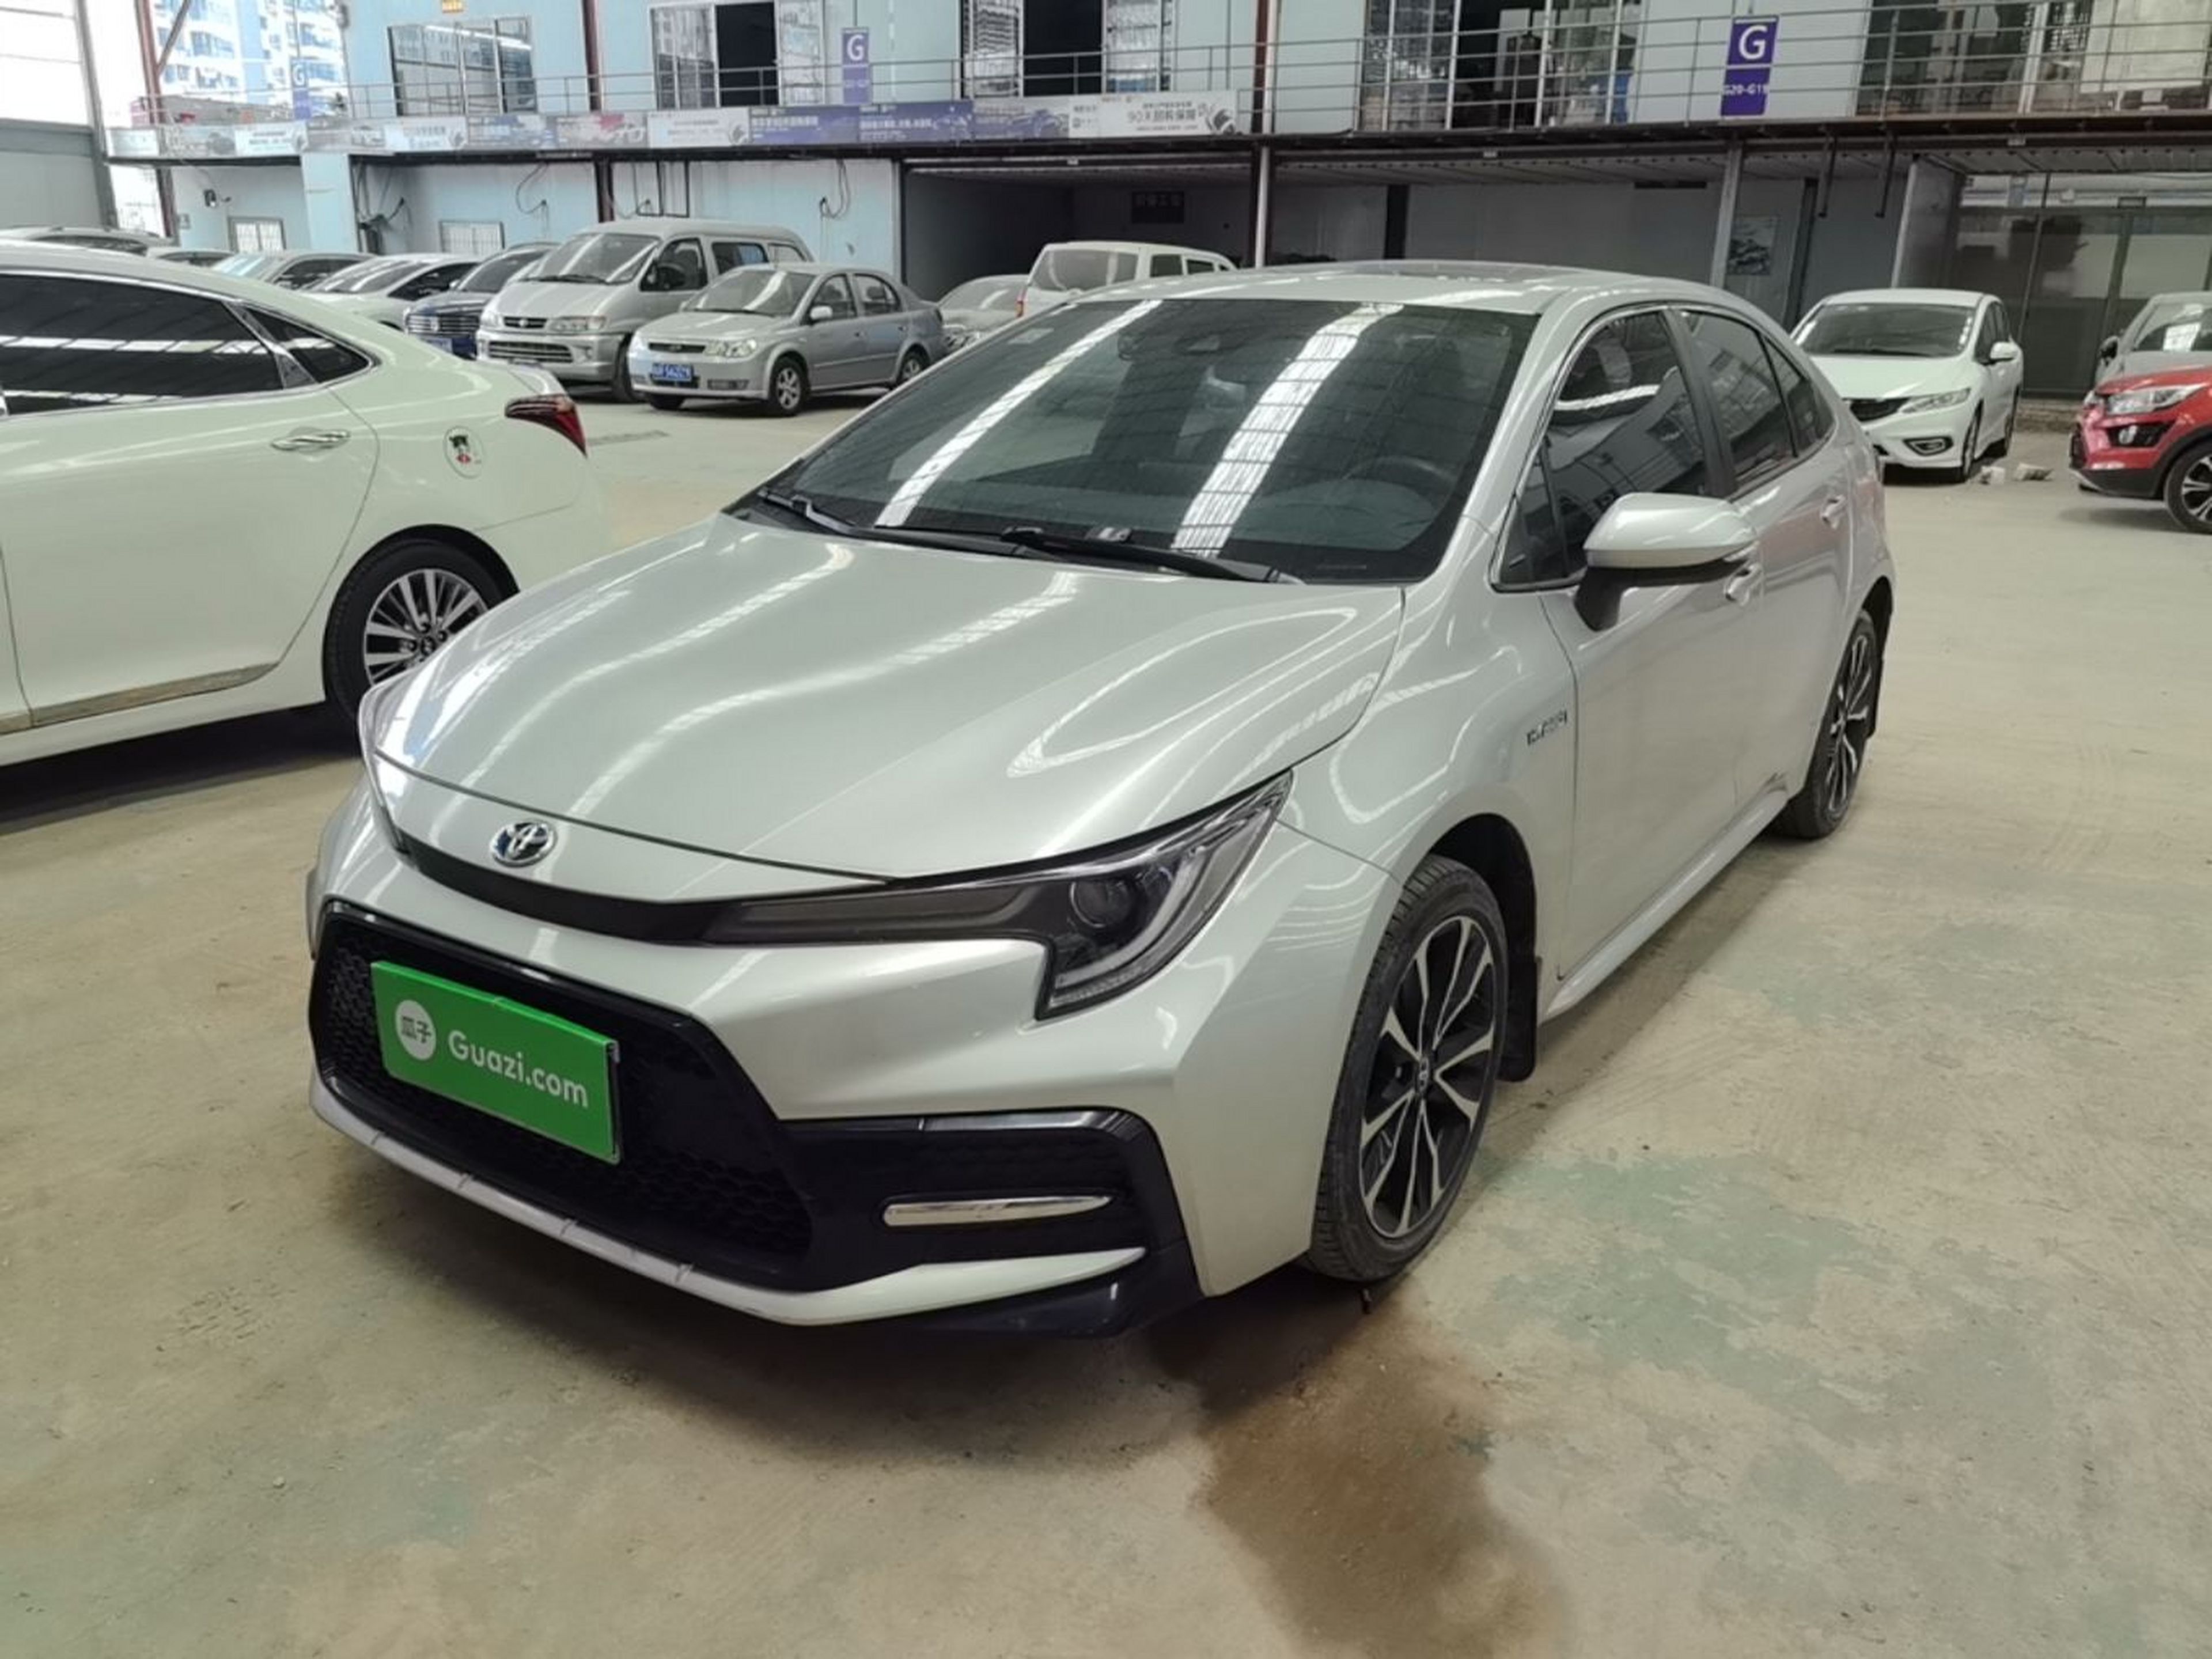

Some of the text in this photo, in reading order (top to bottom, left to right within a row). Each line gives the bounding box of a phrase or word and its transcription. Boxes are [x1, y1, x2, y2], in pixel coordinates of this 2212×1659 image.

[846, 34, 865, 62] G
[1738, 25, 1768, 60] G
[293, 64, 305, 86] G
[402, 1015, 432, 1044] 瓜子
[448, 1029, 589, 1108] Guazi.com
